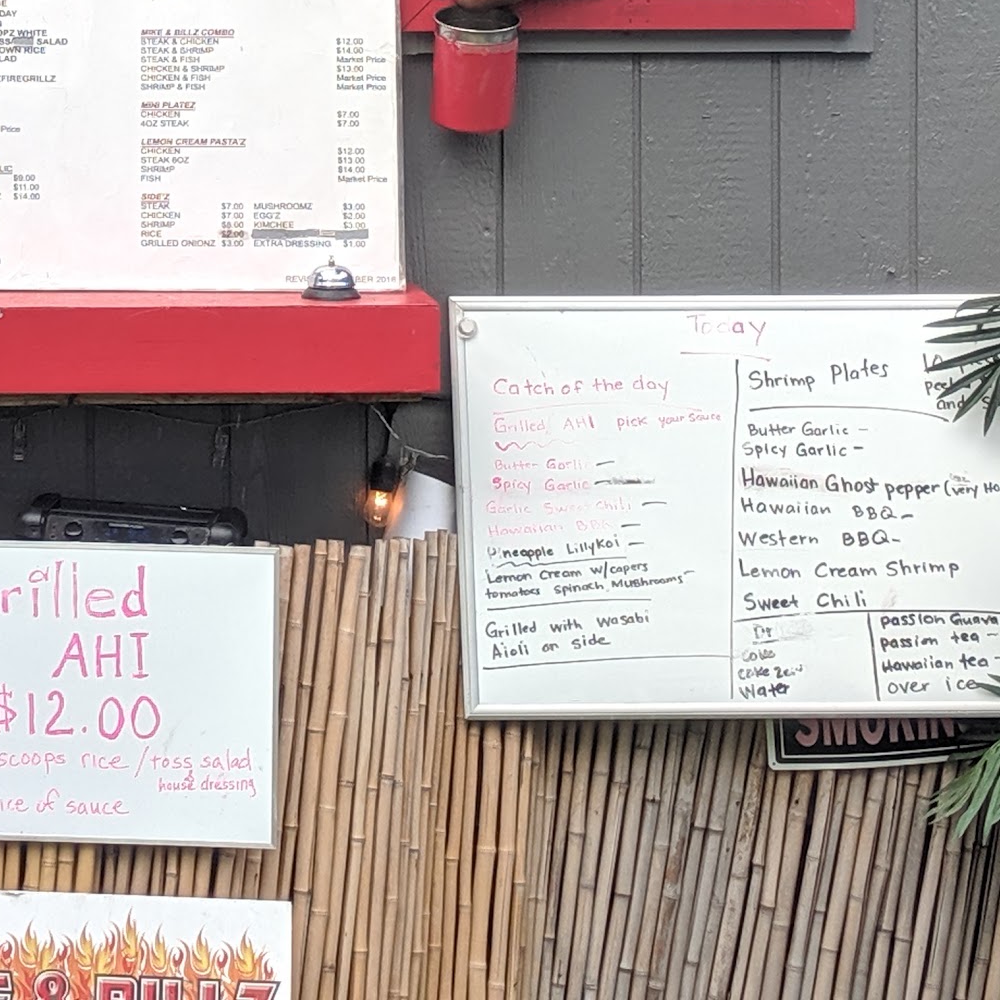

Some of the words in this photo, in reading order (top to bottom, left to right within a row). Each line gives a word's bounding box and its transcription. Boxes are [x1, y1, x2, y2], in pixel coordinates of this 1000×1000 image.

[17, 29, 48, 37] WHITE
[686, 314, 766, 346] Today
[493, 377, 555, 396] Catch
[561, 380, 583, 395] of
[592, 377, 624, 391] the
[632, 374, 669, 401] day
[748, 370, 816, 393] Shrimp
[747, 423, 796, 437] Butter
[801, 421, 849, 437] Garlic
[742, 441, 787, 459] Spicy
[796, 442, 847, 457] Garlic
[544, 478, 591, 491] Garlic
[741, 467, 819, 490] Hawaiian
[825, 473, 879, 494] Ghost
[885, 481, 941, 501] pepper
[741, 496, 832, 515] Hawaiian
[738, 529, 819, 547] Western
[486, 570, 533, 585] Lemon
[739, 558, 801, 578] Lemon
[814, 562, 878, 578] Cream
[886, 559, 960, 579] Shrimp
[743, 592, 799, 611] Sweet
[817, 589, 867, 609] Chili
[485, 620, 537, 638] Grilled
[550, 618, 583, 634] with
[951, 629, 980, 644] tea
[51, 632, 150, 679] AHI
[492, 641, 530, 660] Aioli
[542, 643, 559, 653] on
[882, 656, 954, 674] Hawaiian
[959, 652, 989, 668] tea
[888, 681, 930, 695] over
[946, 675, 978, 692] ice
[81, 753, 130, 770] rice
[200, 747, 252, 771] salad
[36, 788, 61, 814] of
[66, 798, 130, 815] sauce
